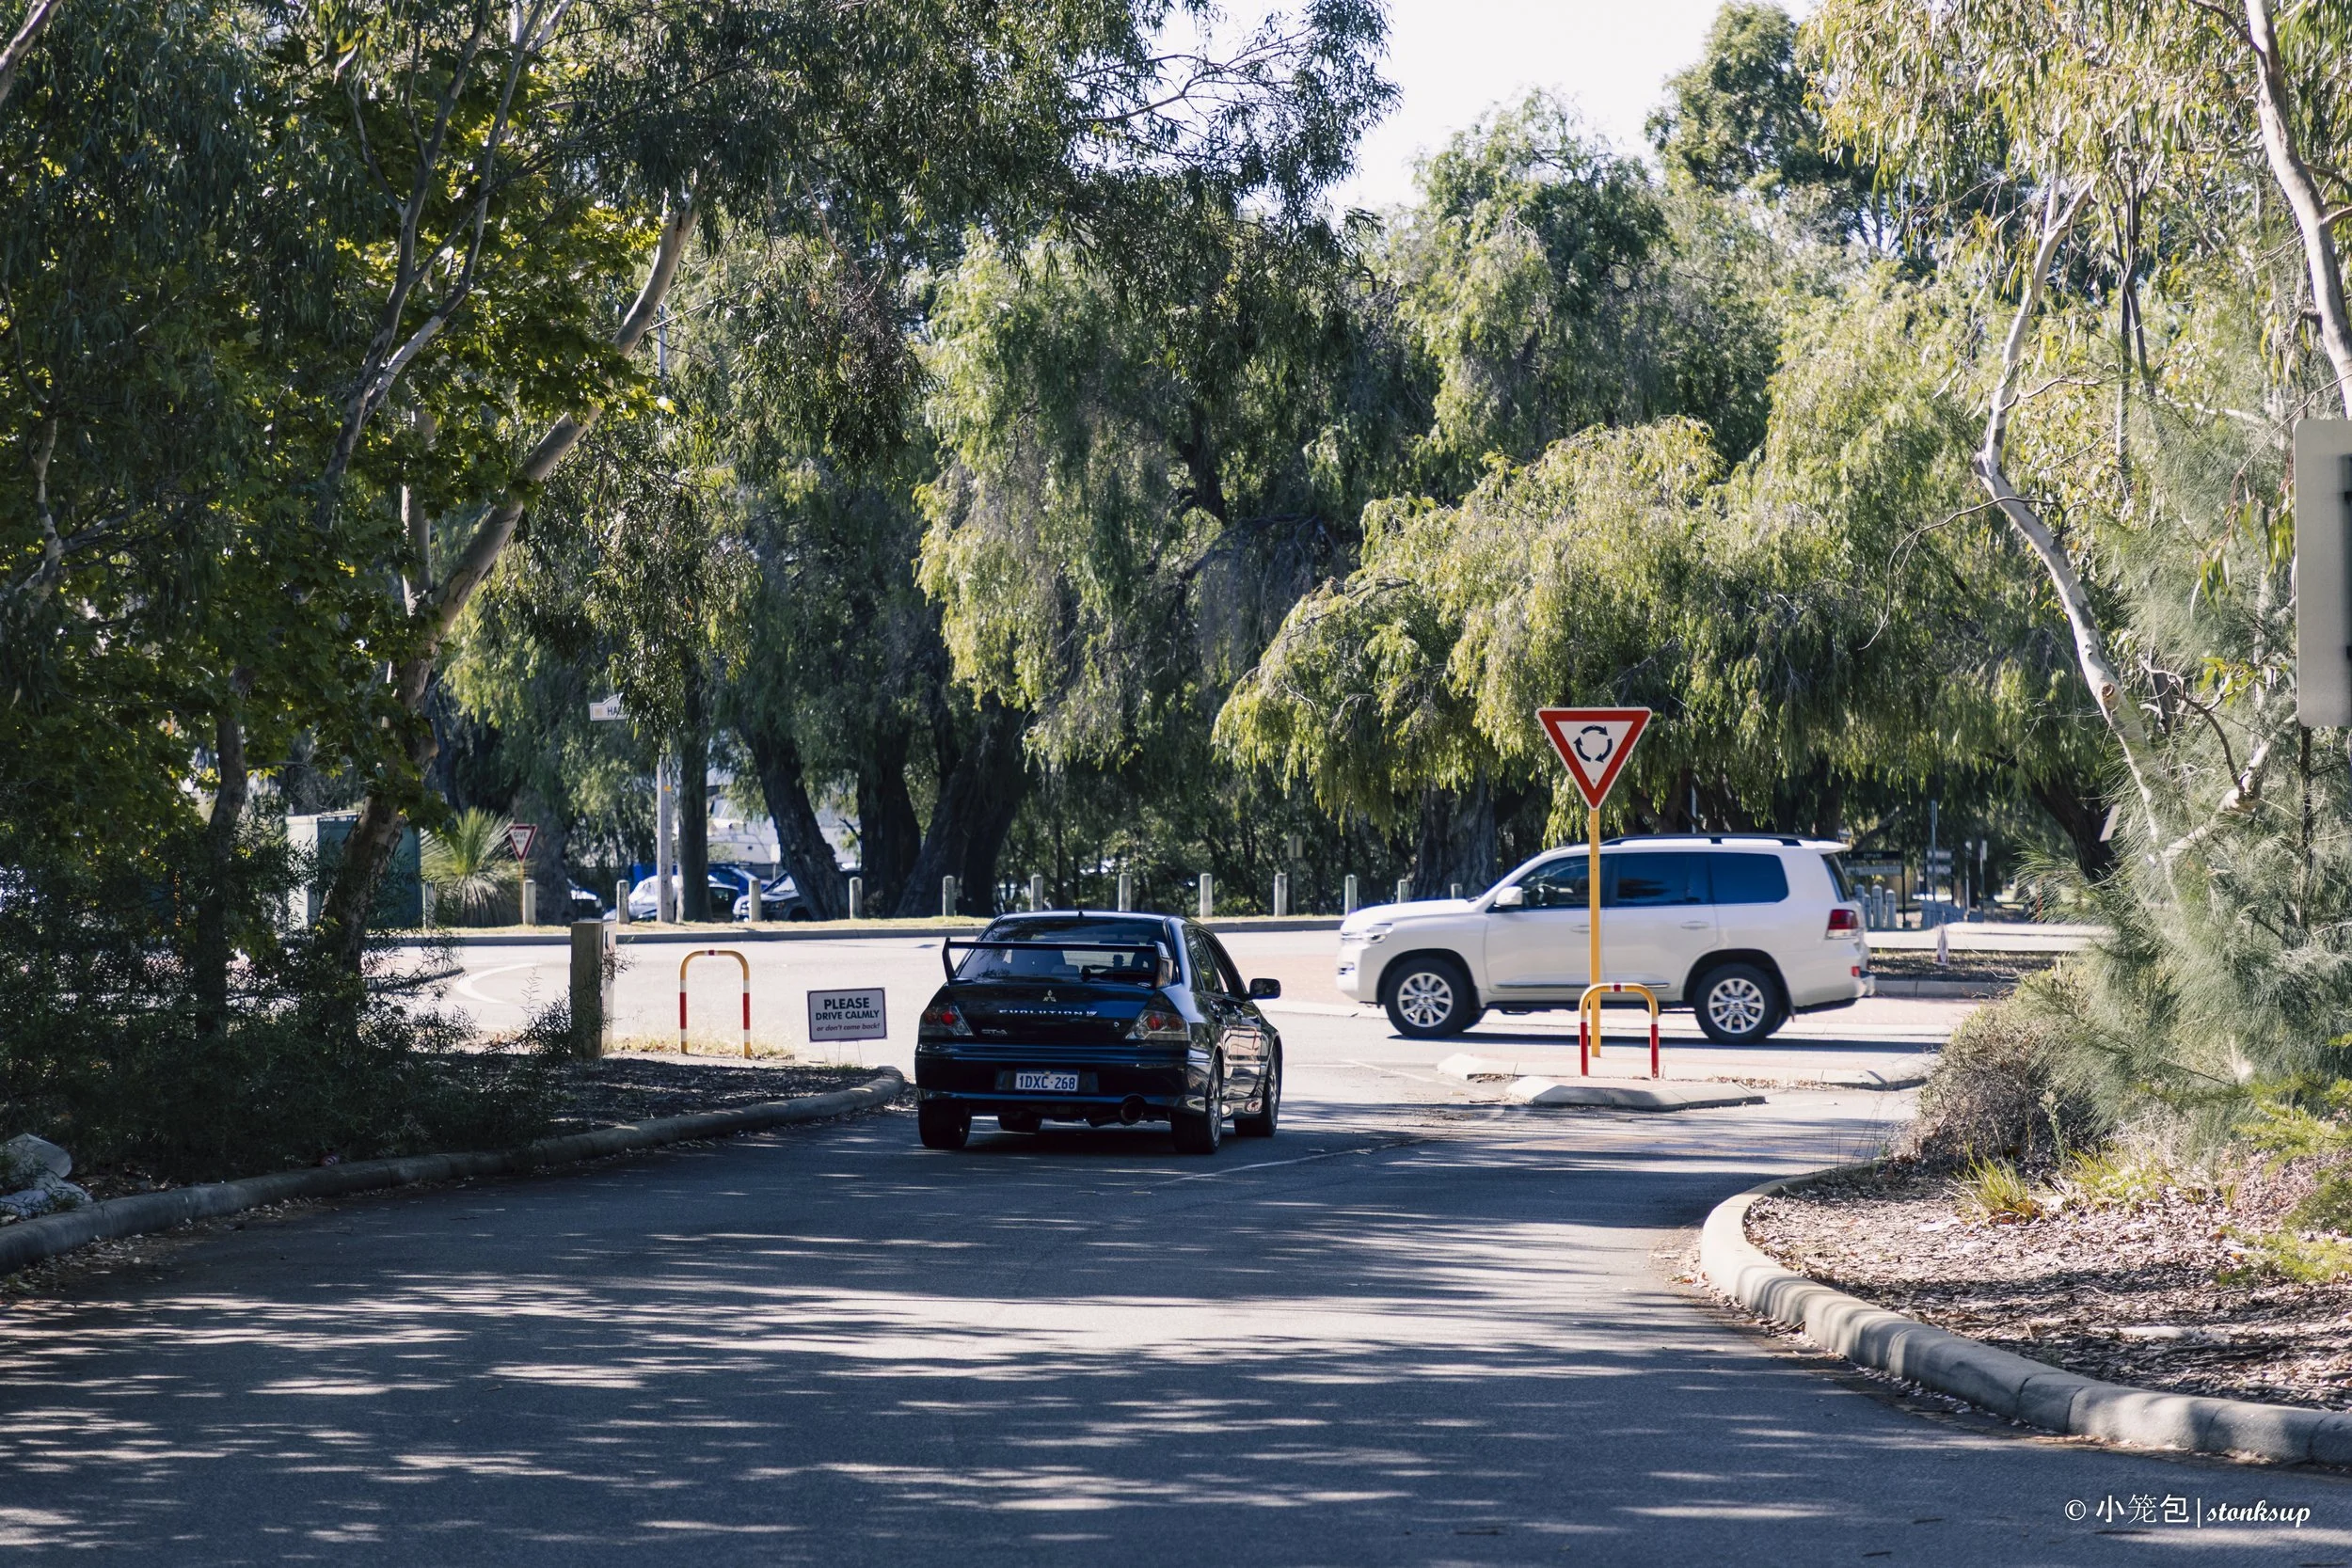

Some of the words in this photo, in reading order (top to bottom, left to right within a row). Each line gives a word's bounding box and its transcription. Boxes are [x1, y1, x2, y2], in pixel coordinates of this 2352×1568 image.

[824, 997, 870, 1010] PLEASE
[815, 1011, 842, 1021] DRIVE
[845, 1009, 880, 1020] CALMLY
